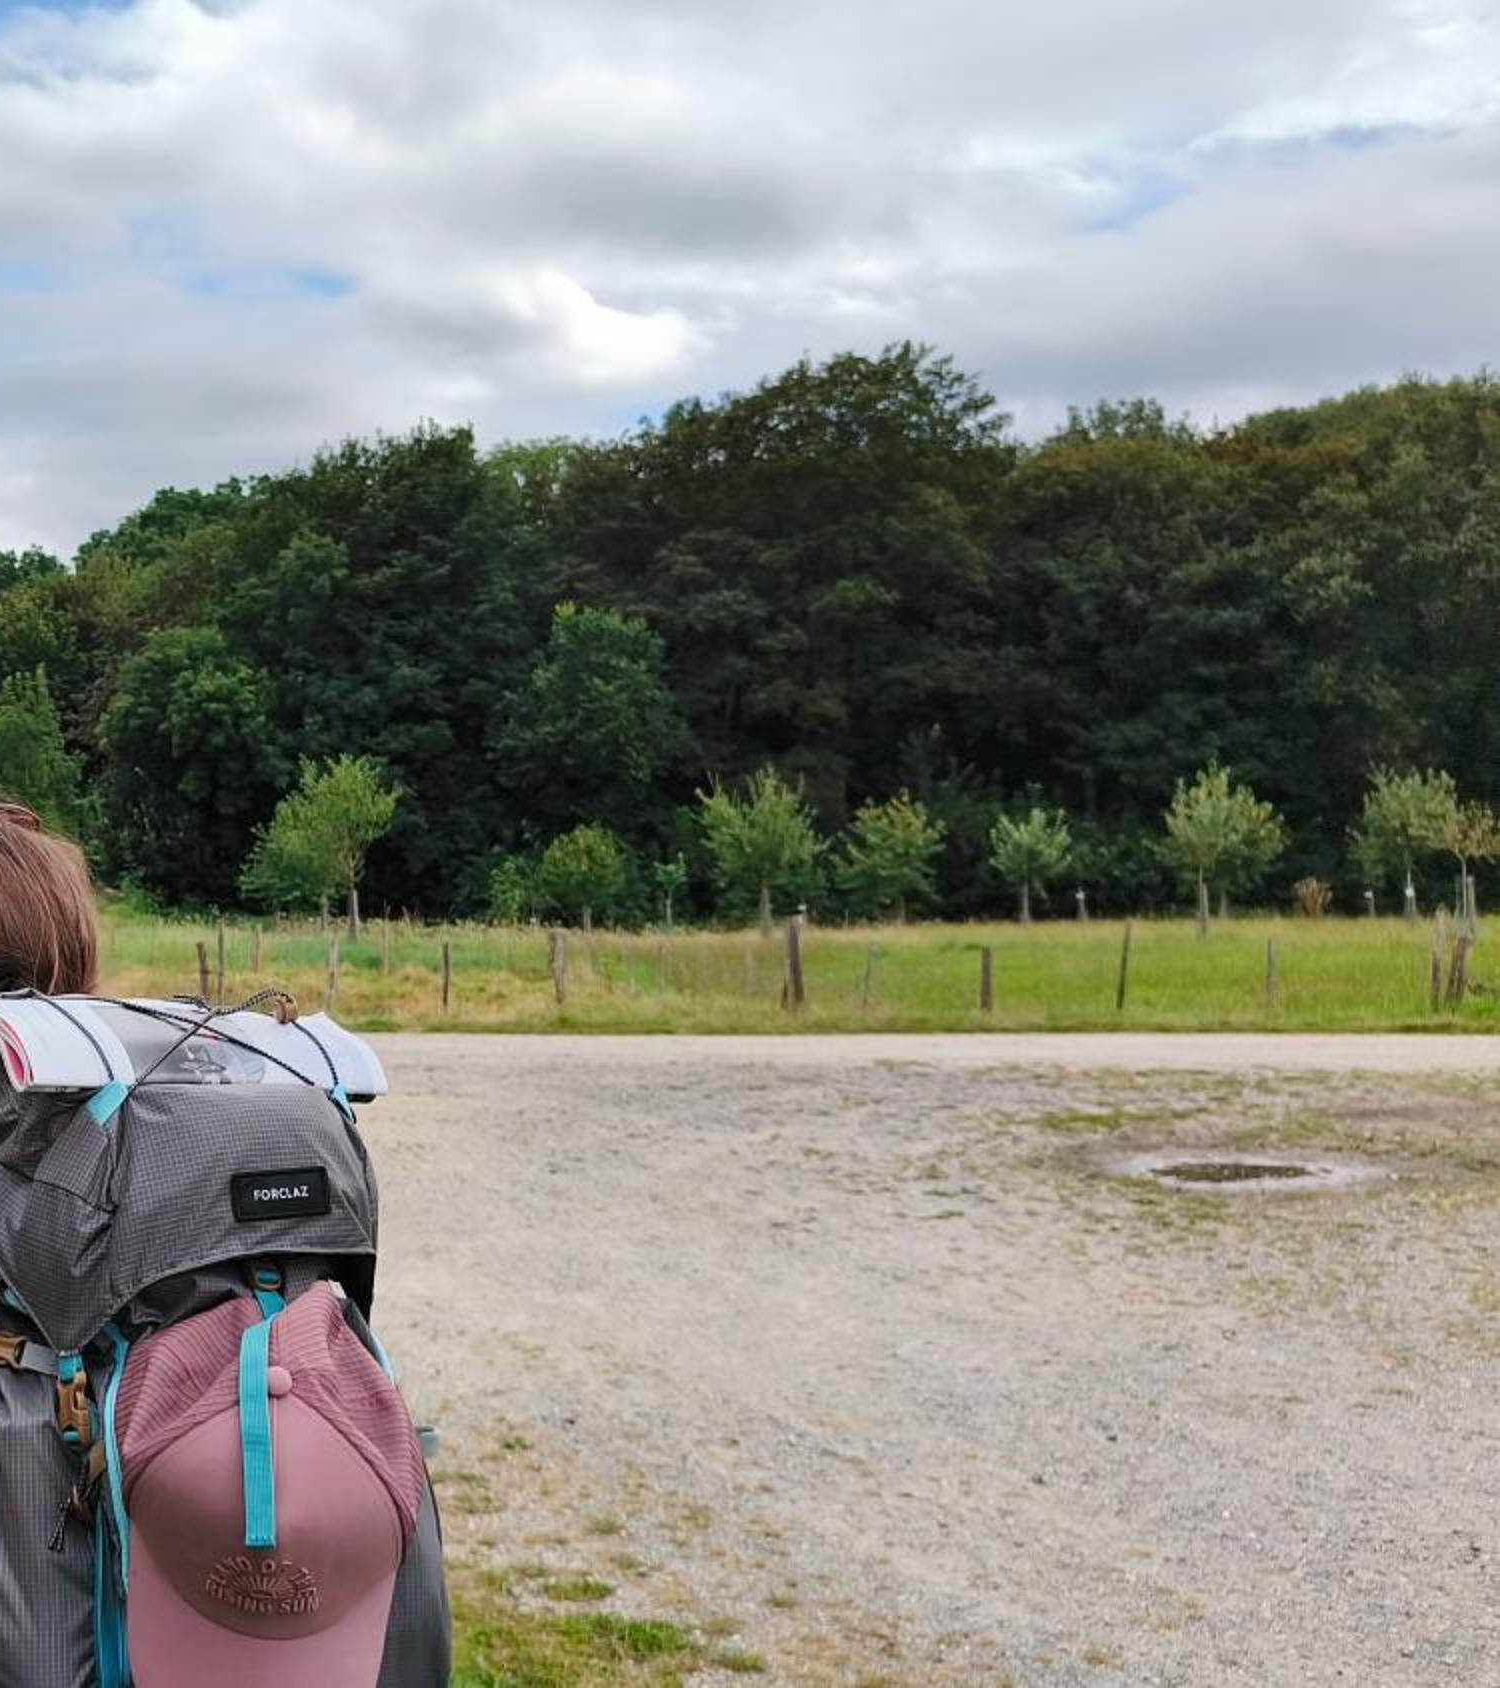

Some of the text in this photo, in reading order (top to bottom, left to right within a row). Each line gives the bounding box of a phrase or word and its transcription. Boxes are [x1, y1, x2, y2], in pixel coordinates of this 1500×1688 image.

[253, 1185, 309, 1201] FORCLAZ
[209, 1555, 253, 1584] LAND
[205, 1579, 319, 1616] RISING SUN
